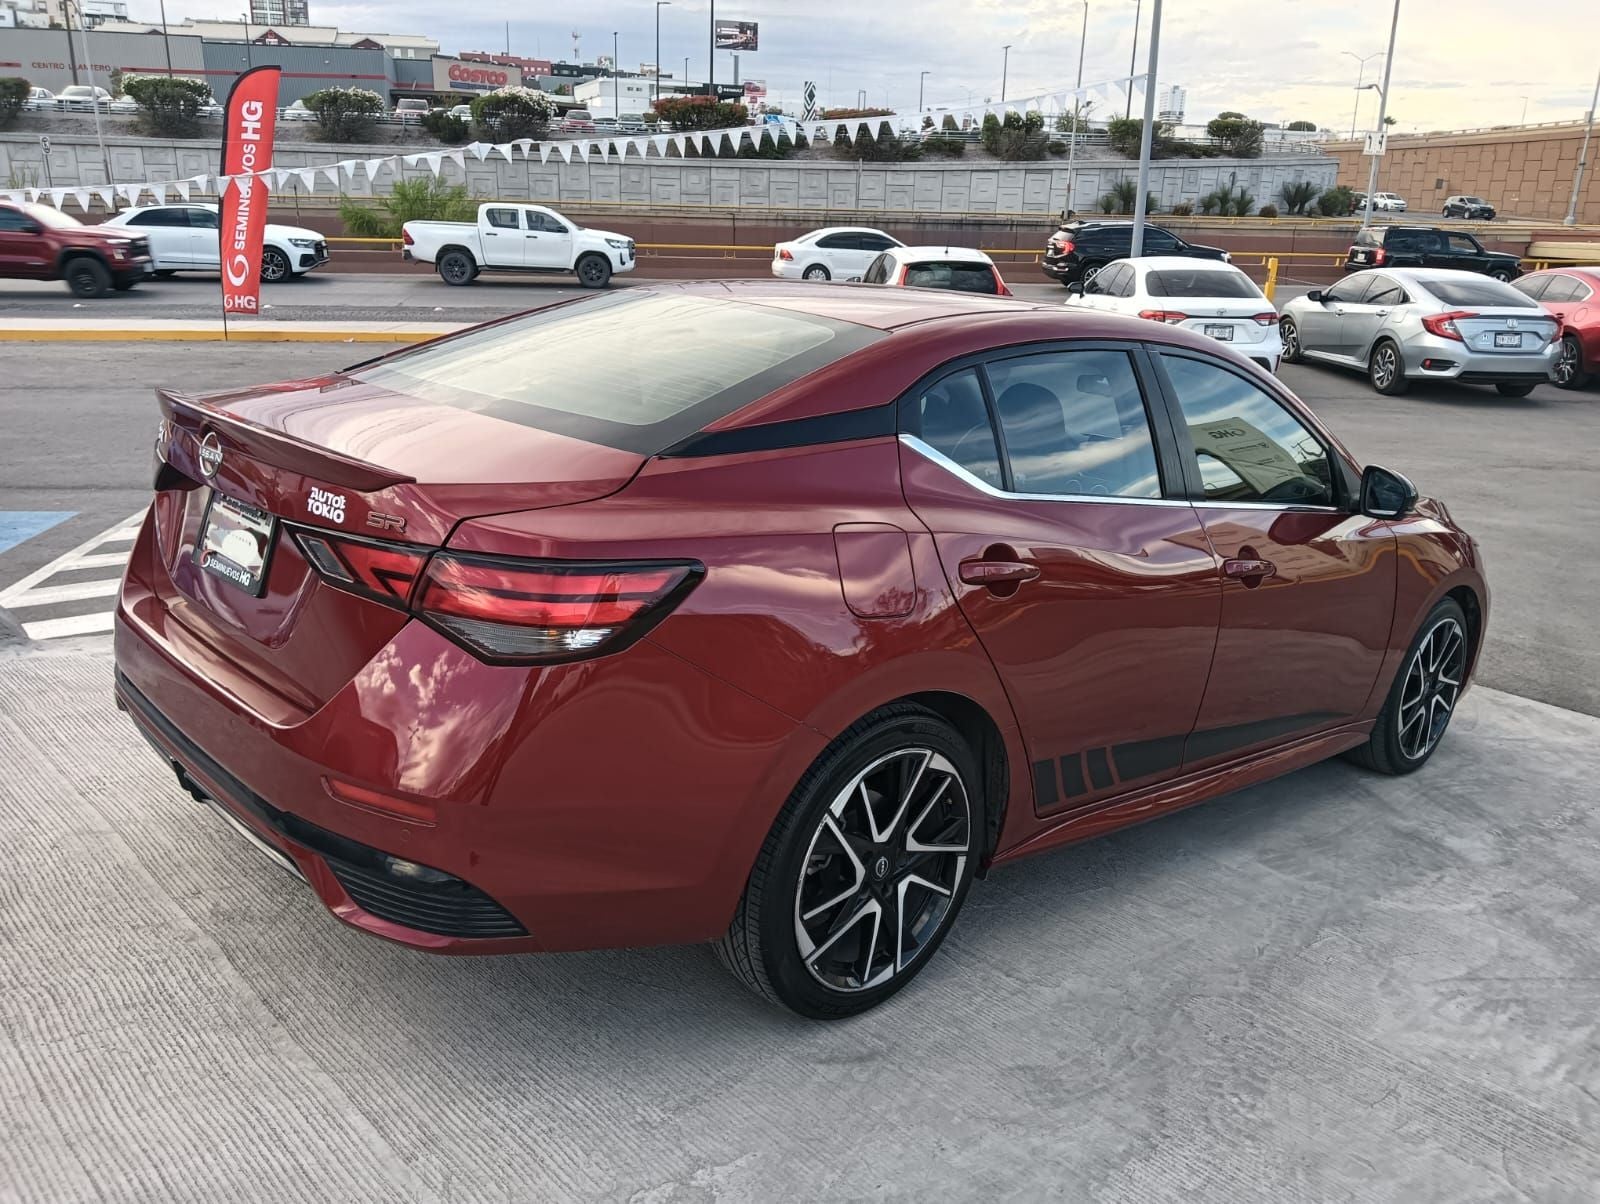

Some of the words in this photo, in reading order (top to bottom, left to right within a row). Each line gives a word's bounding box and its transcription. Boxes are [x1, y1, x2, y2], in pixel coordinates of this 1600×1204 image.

[32, 62, 65, 70] CENTRO
[68, 63, 112, 72] LANTERO
[448, 64, 508, 86] COSTCO
[241, 100, 263, 140] HG
[234, 143, 256, 250] SEMINVOS
[234, 295, 257, 310] HG
[307, 498, 345, 524] TOKIO
[366, 510, 407, 534] SR
[209, 558, 240, 581] SEMINUEVOS
[238, 570, 252, 586] HG
